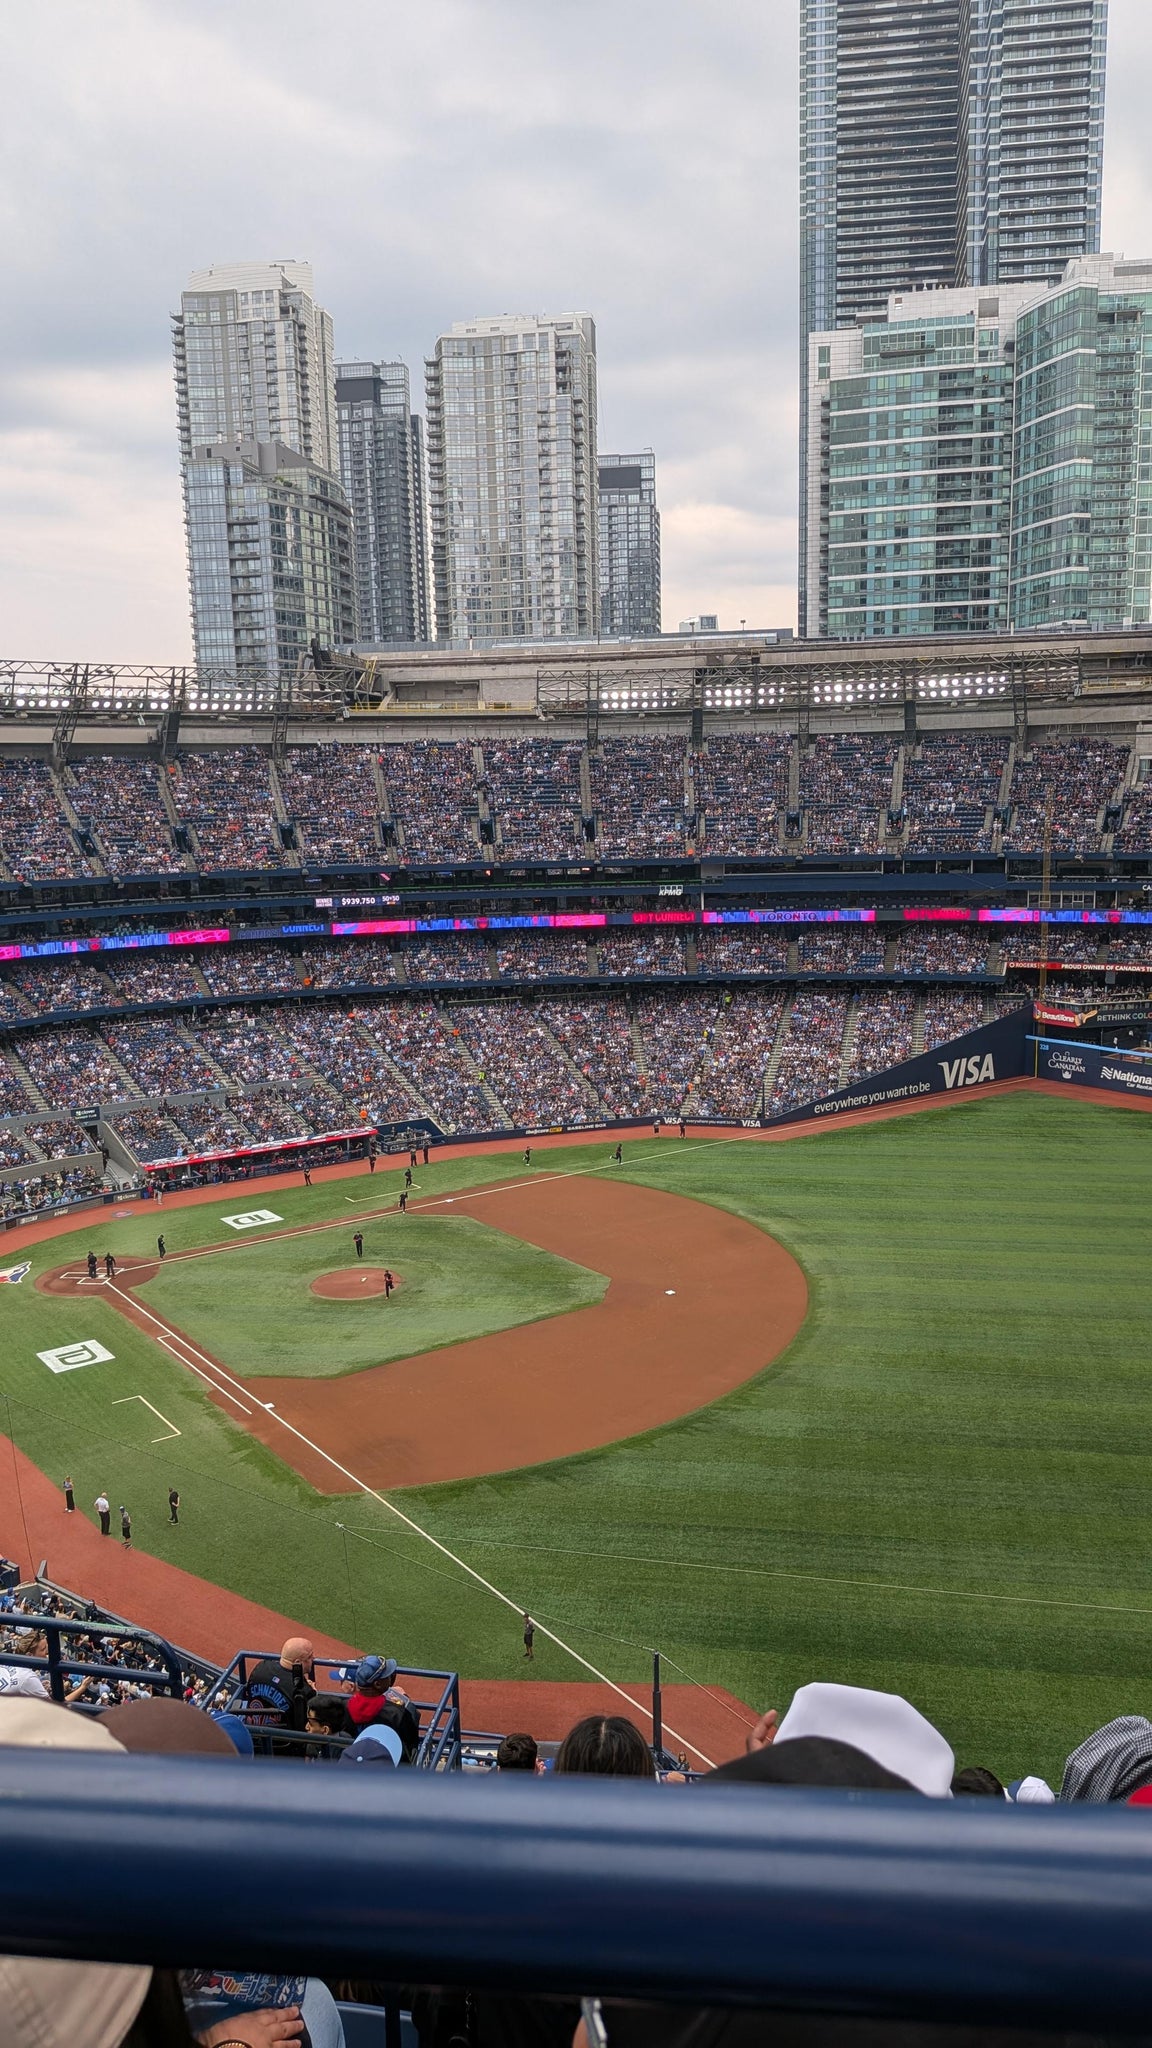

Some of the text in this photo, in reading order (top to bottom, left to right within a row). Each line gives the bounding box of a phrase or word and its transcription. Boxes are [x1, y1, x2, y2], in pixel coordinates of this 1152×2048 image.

[659, 886, 683, 896] KPMG
[761, 912, 818, 921] TORONTO
[1082, 963, 1105, 971] OWNER
[1115, 964, 1146, 972] CANADA'S
[1097, 1012, 1131, 1022] RETHINK
[937, 1053, 995, 1089] VISA
[814, 1081, 931, 1114] everywhere you want to be
[741, 1119, 761, 1127] VISA
[251, 1684, 289, 1711] SCHNEIDER
